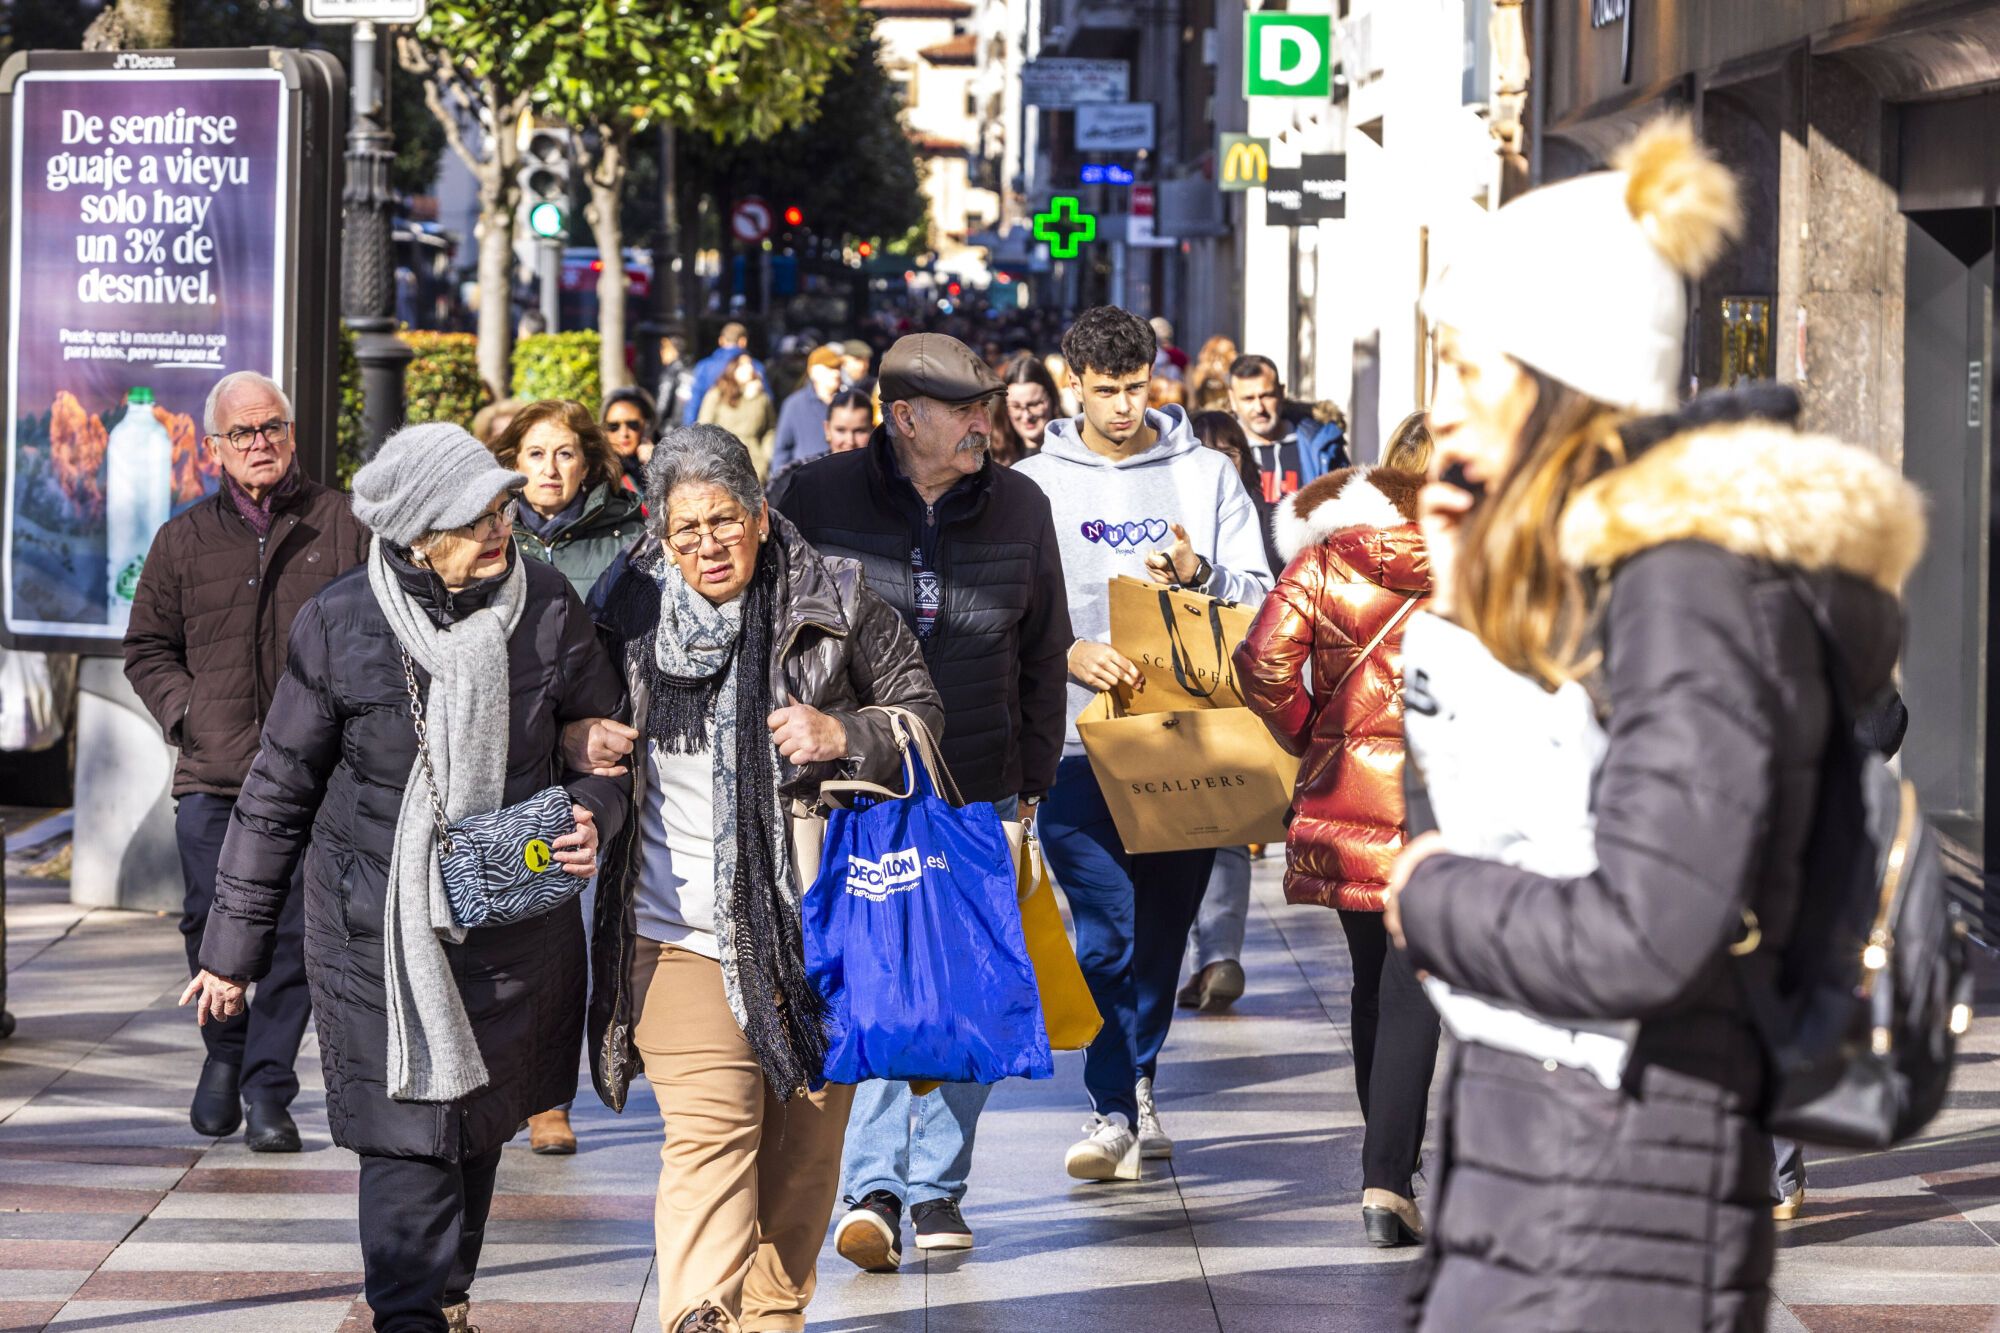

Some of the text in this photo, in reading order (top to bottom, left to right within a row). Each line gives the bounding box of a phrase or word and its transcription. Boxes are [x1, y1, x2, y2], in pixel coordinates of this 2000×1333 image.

[61, 107, 238, 144] De sentirse
[47, 147, 249, 192] guaje a vieyu
[80, 189, 212, 231] solo hay
[76, 228, 213, 264] un 3% de
[77, 267, 217, 304] desnivel.
[59, 328, 227, 347] Puede que la montaña no sea
[63, 346, 90, 361] para
[127, 346, 157, 363] pero
[1131, 774, 1245, 794] SCALPERS
